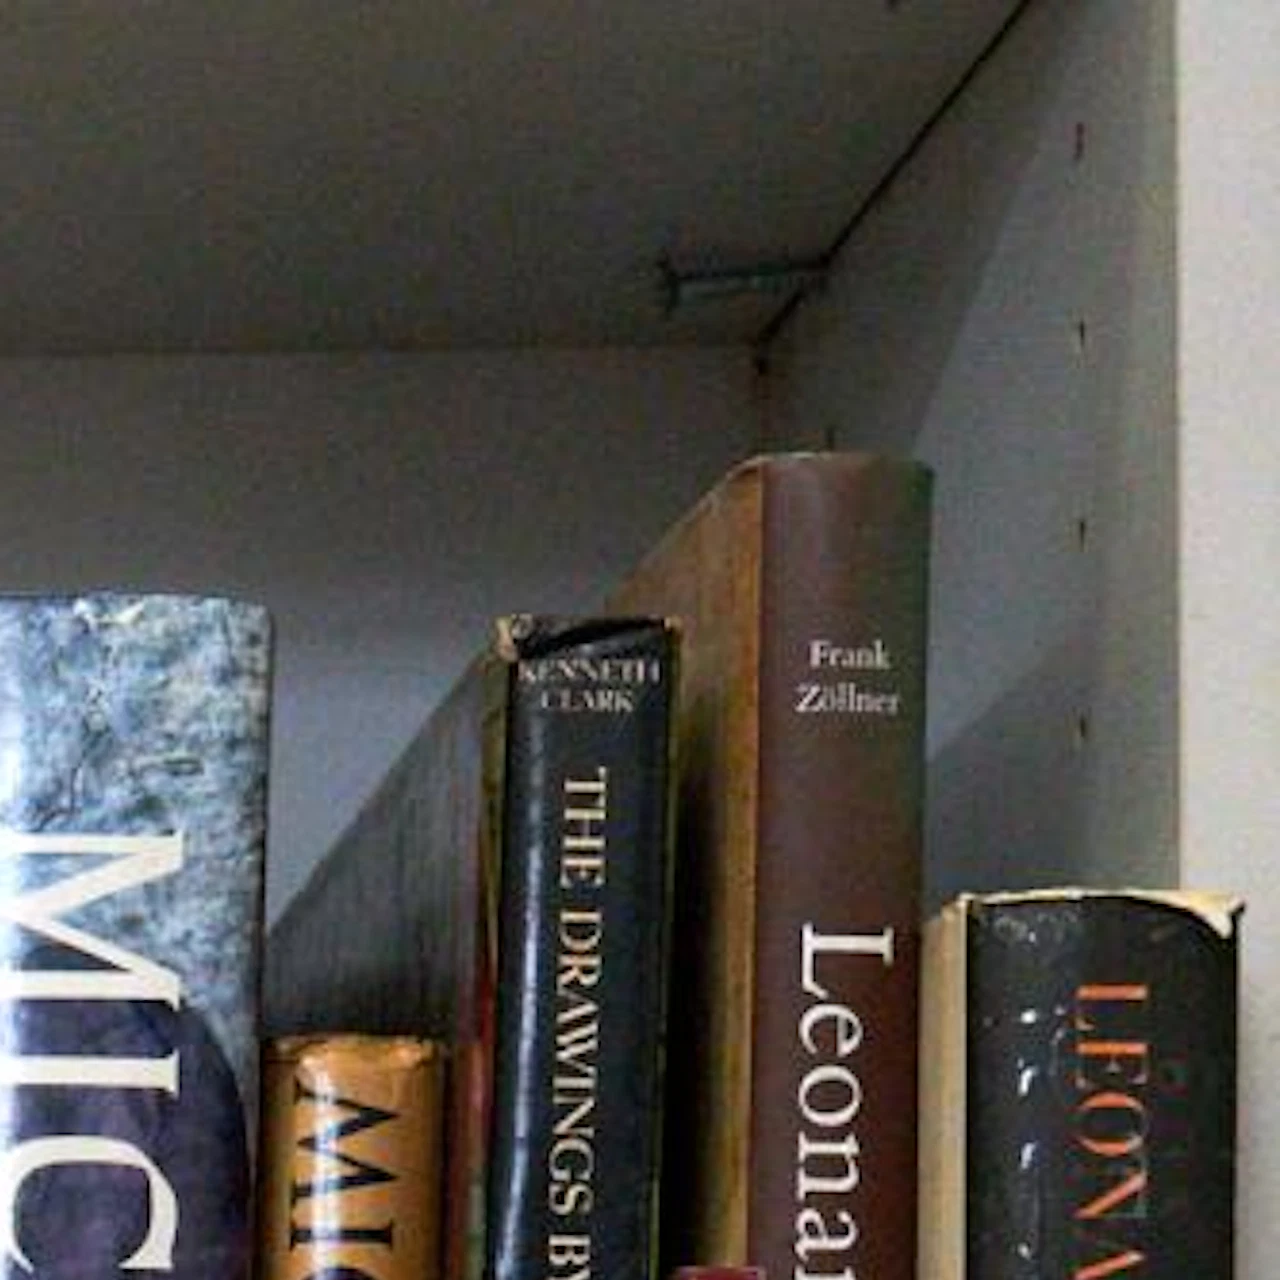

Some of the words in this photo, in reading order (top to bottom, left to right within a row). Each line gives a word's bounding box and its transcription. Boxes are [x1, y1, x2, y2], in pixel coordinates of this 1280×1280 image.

[809, 640, 891, 670] Frank
[795, 684, 900, 713] Zöllner
[559, 766, 607, 889] THE
[548, 908, 603, 1215] DRAWINGS
